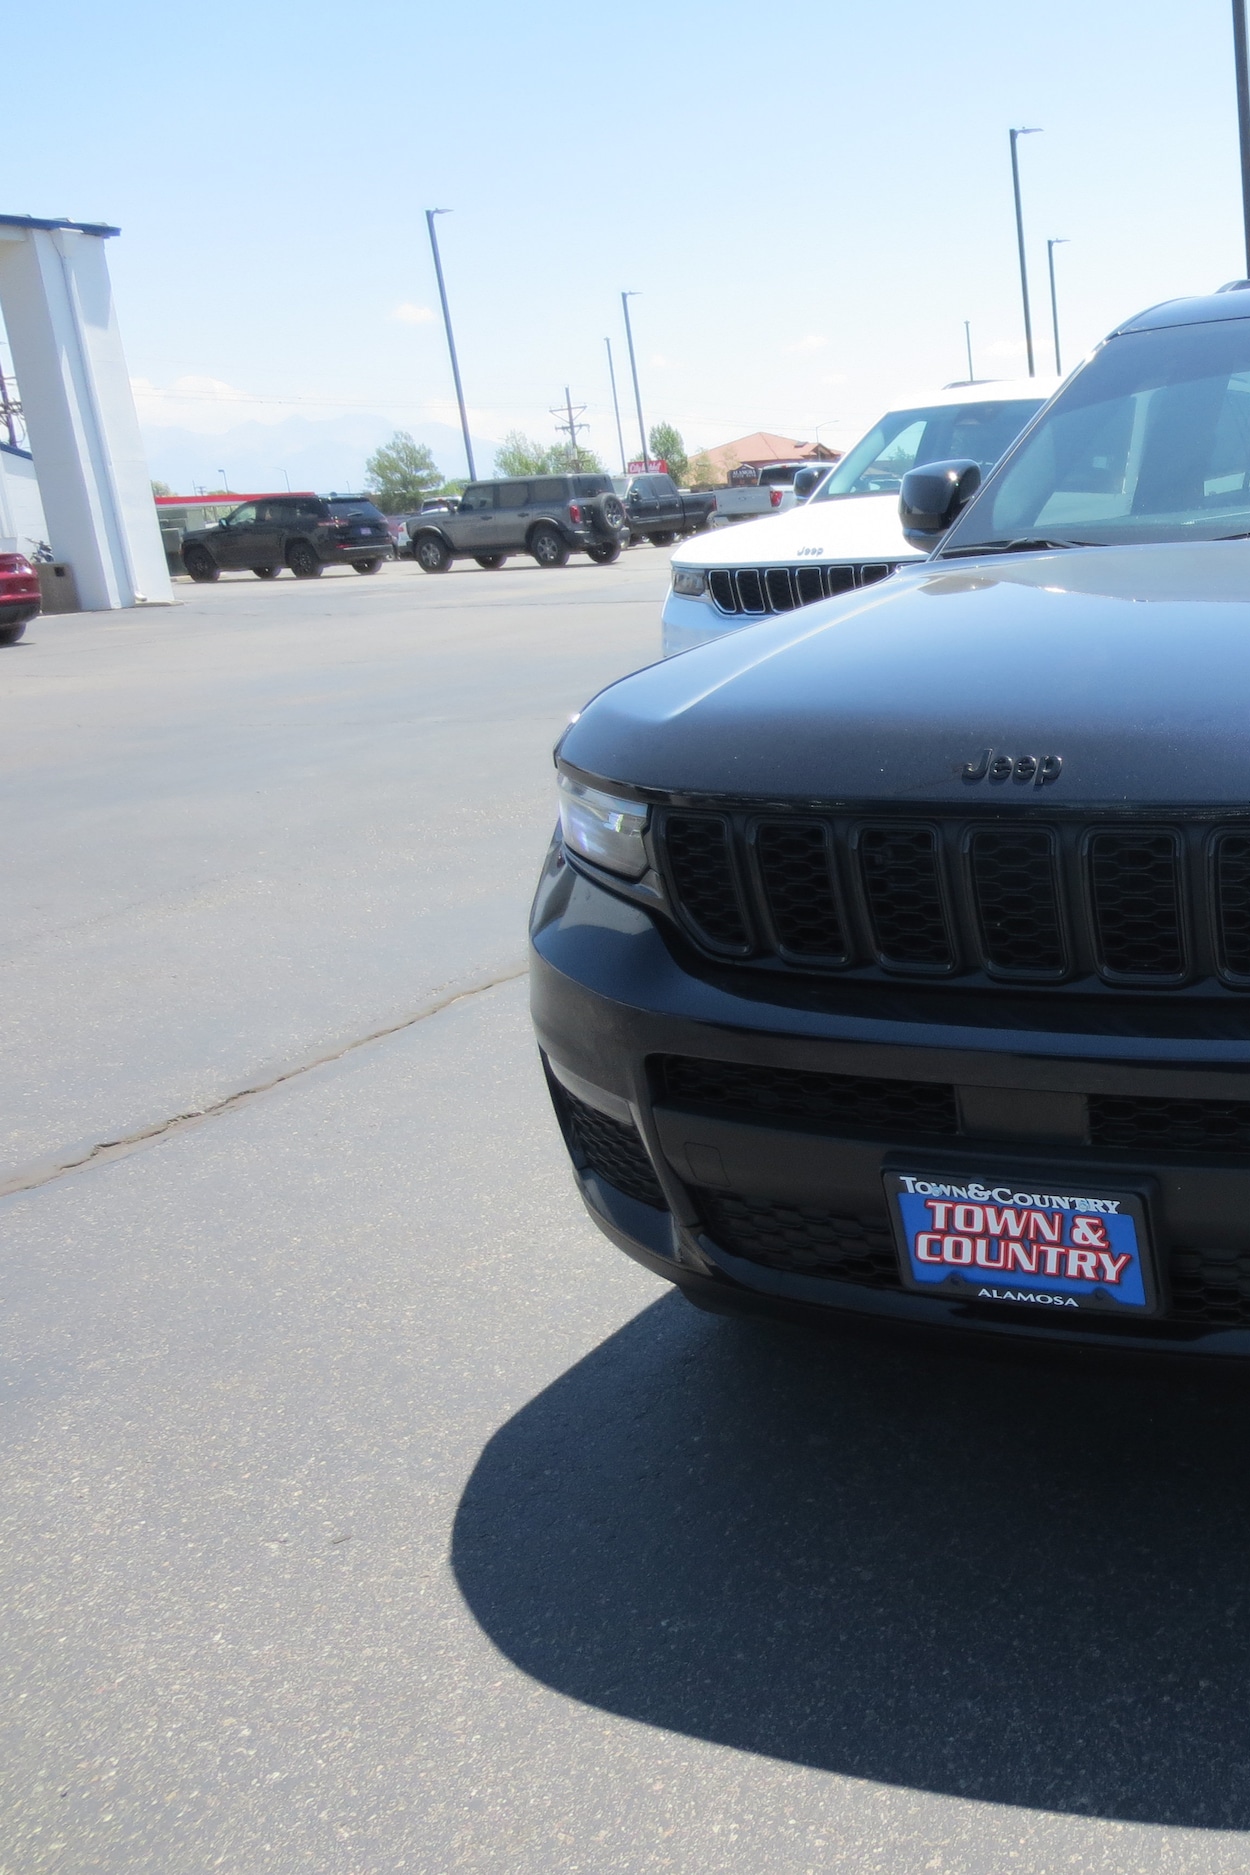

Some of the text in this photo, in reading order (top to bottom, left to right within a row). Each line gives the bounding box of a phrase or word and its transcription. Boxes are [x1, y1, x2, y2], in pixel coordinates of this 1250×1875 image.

[797, 546, 824, 557] Jeep
[962, 748, 1062, 787] Jeep
[925, 1199, 1110, 1249] TOWN &
[914, 1231, 1131, 1284] COUNTRY
[977, 1288, 1080, 1307] ALAMOSA
